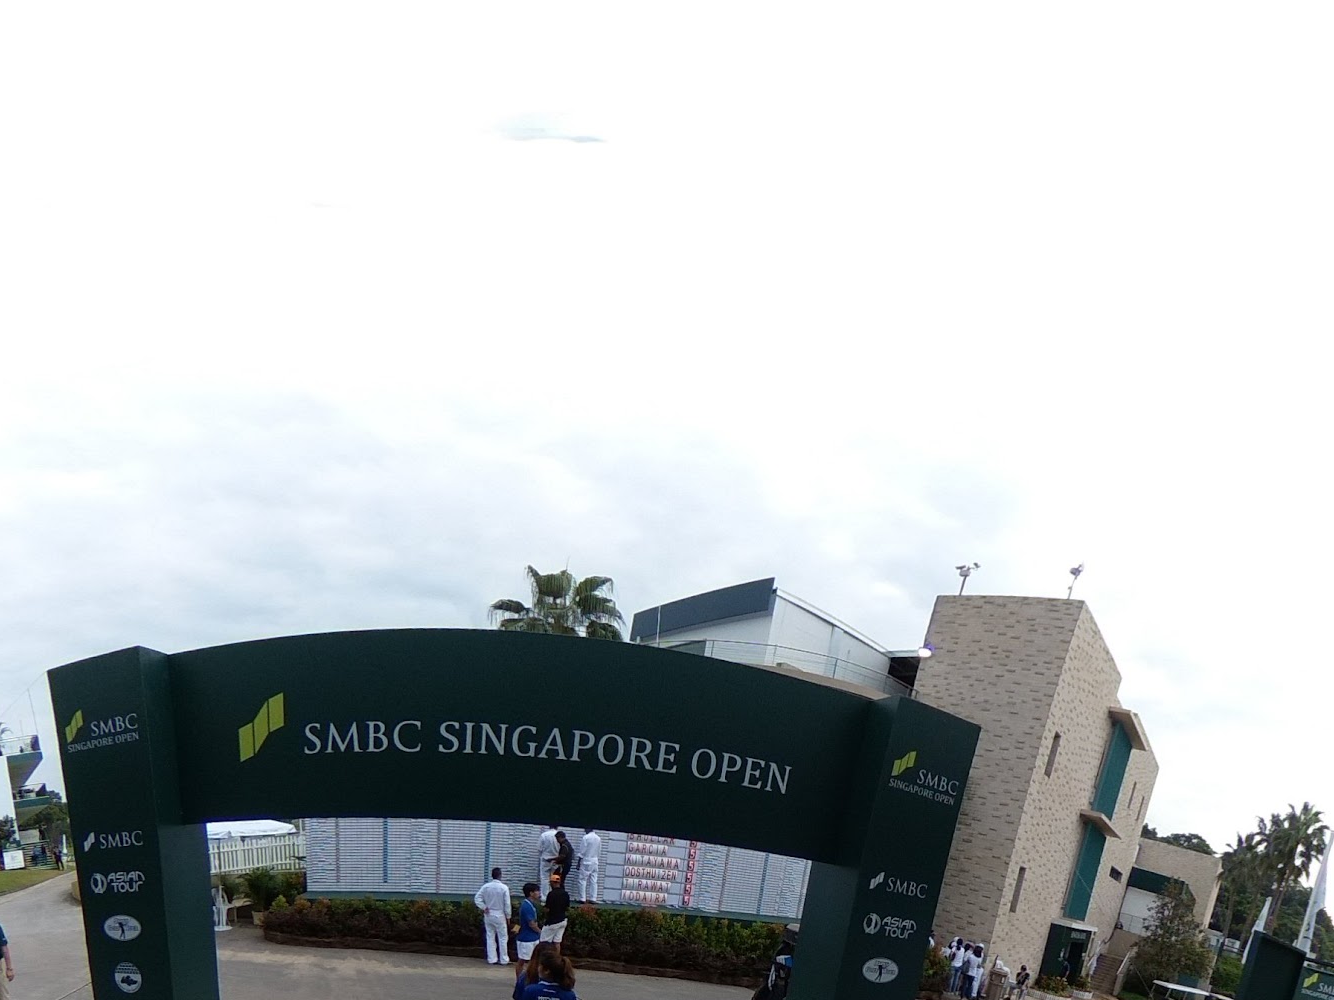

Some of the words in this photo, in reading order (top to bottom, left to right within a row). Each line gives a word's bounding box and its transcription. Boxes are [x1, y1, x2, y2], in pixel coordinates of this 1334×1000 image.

[90, 713, 139, 737] SMBC
[67, 736, 114, 753] SINGAPORE
[115, 731, 139, 744] OPEN
[304, 720, 422, 754] SMBC
[438, 721, 681, 774] SINGAPORE
[690, 748, 792, 794] OPEN
[917, 769, 959, 795] SMBC
[888, 778, 934, 799] SINGAPORE
[934, 792, 955, 806] OPEN
[99, 831, 144, 849] SMBC
[629, 842, 667, 854] GARCIA
[626, 855, 679, 869] KITAYAMA
[688, 861, 695, 871] 5
[108, 871, 145, 882] ASIAN
[625, 867, 677, 880] OOSTHUIZEN
[687, 873, 693, 883] 5
[111, 881, 143, 893] TOUR
[886, 877, 928, 898] SMBC
[622, 892, 667, 903] KODAIRA
[882, 916, 916, 930] ASIAN
[885, 926, 914, 939] TOUR
